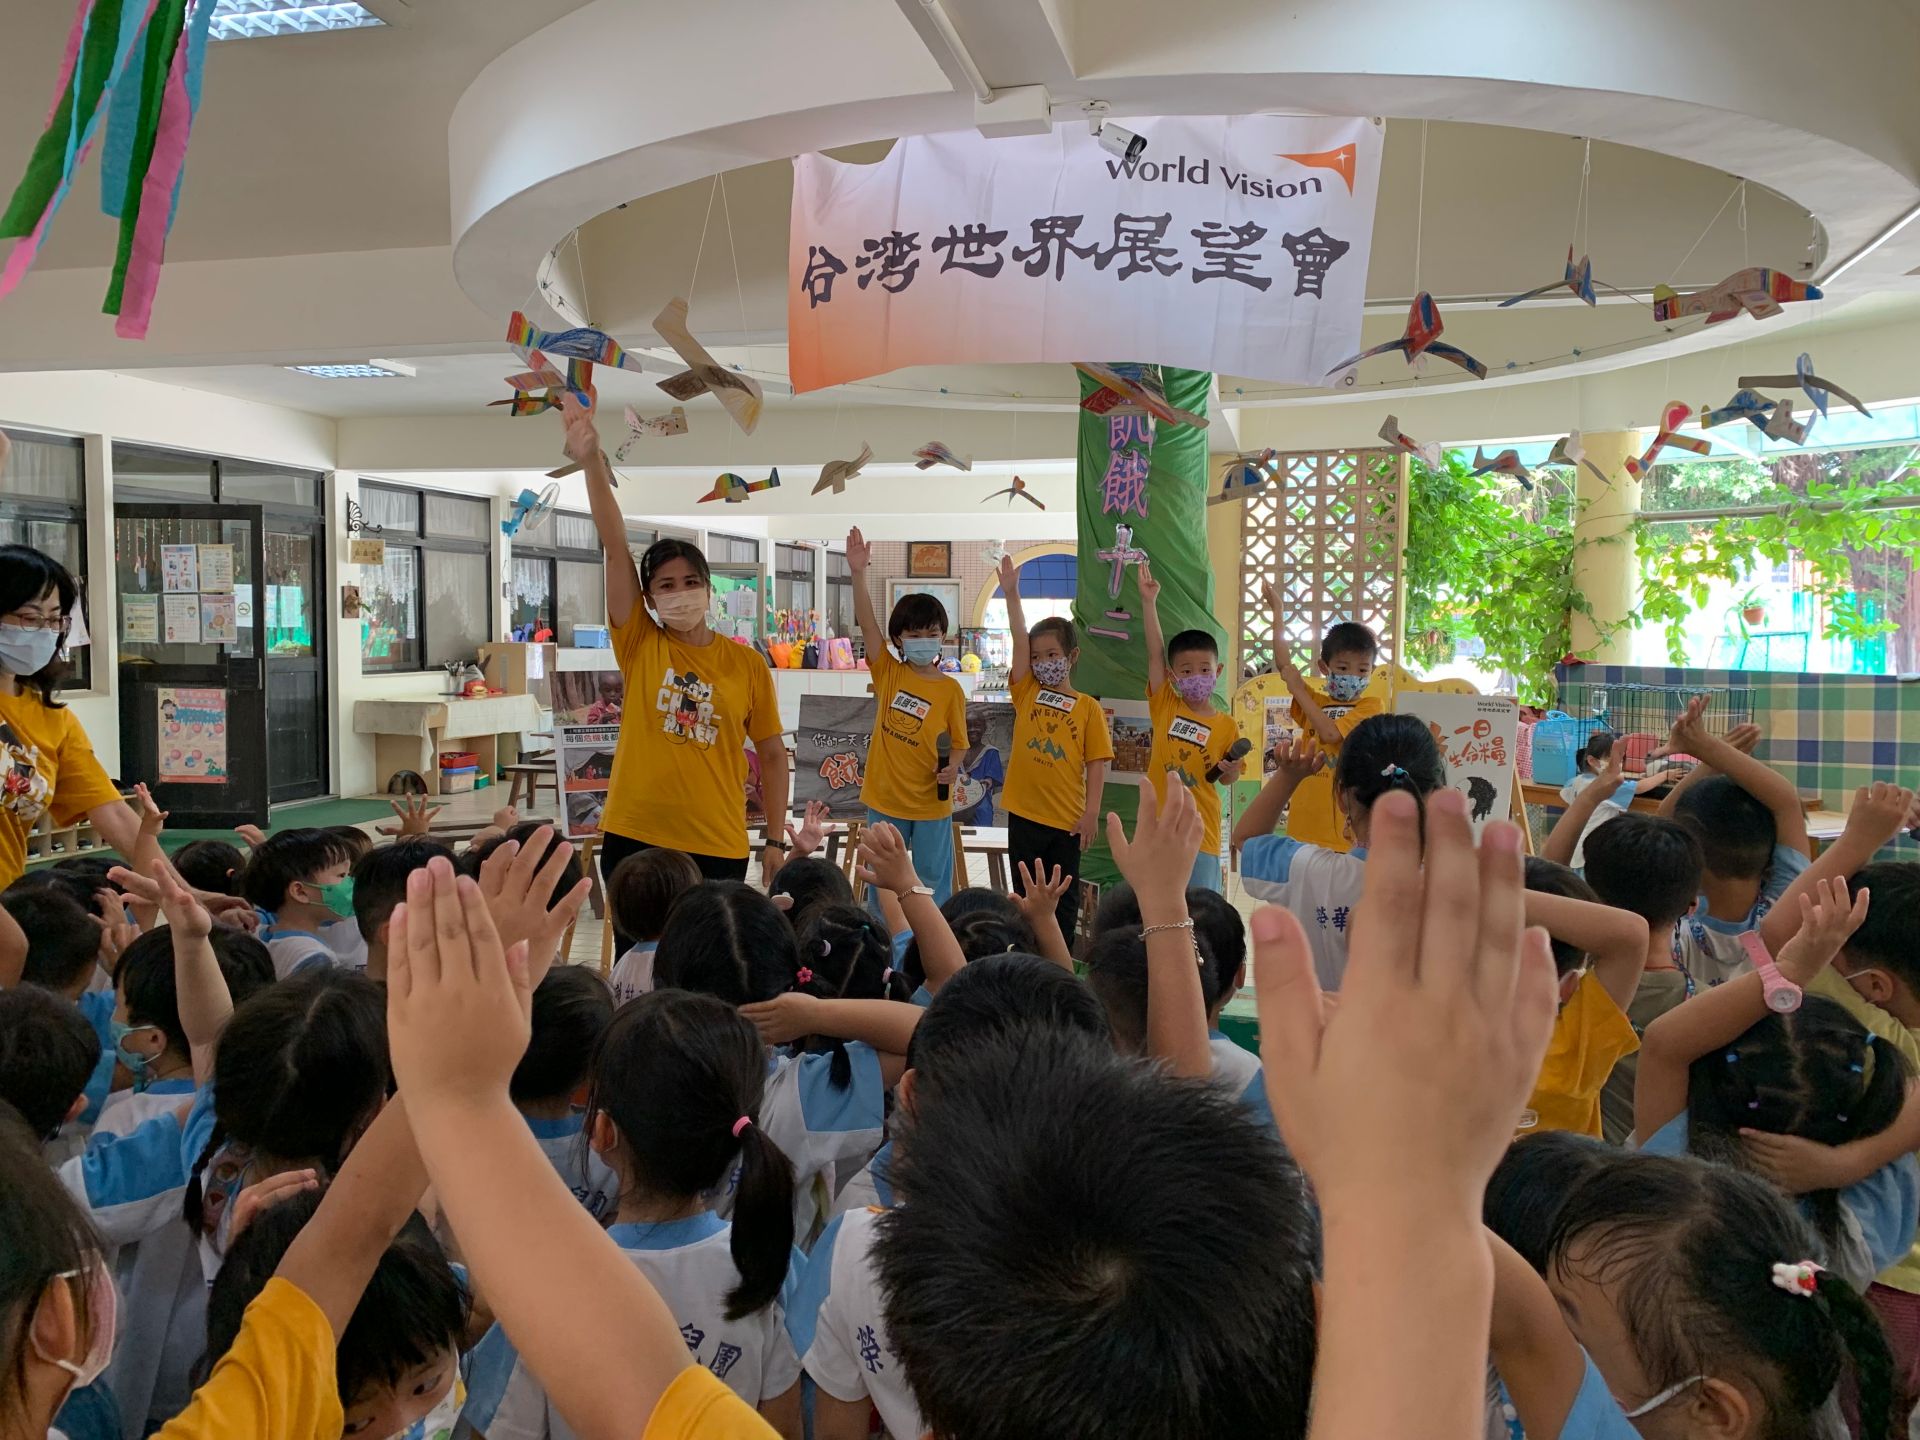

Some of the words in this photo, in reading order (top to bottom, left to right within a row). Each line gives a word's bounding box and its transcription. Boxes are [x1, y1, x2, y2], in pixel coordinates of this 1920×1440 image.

[1105, 155, 1209, 185] World
[1220, 166, 1323, 198] Vision
[802, 212, 1350, 309] 台灣世界展望會
[812, 732, 858, 749] 你的一天
[1454, 719, 1492, 740] 一日
